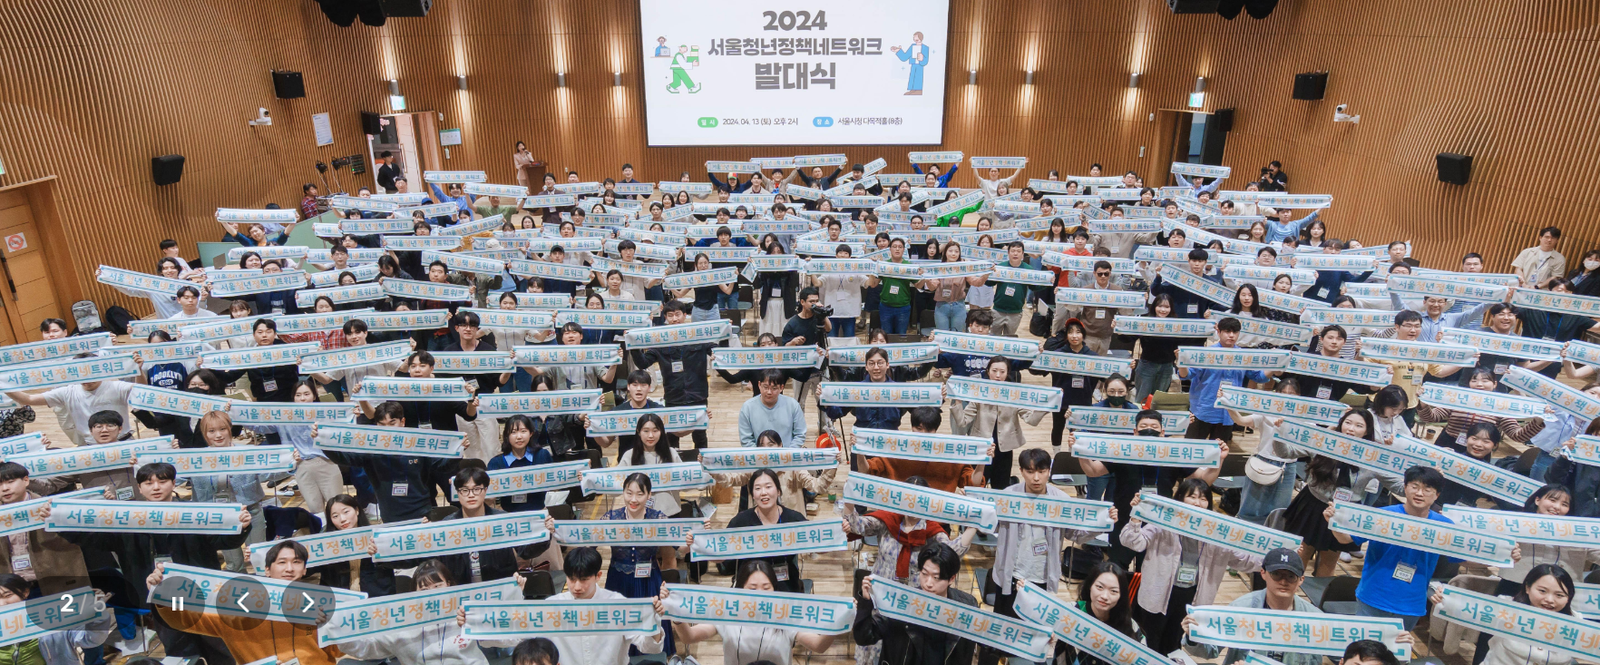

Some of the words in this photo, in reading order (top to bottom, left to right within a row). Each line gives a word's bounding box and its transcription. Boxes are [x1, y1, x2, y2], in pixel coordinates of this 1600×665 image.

[762, 10, 828, 31] 2024
[708, 38, 882, 56] 서울청년정책네트워크
[754, 62, 836, 90] 발대식
[1398, 282, 1494, 298] 서울청년정책네트워크
[566, 315, 642, 324] 서울청년정책네트워크
[1124, 321, 1206, 334] 서울청년정책네트워크
[635, 326, 721, 344] 서울청년정책네트워크
[942, 338, 1028, 355] 서울청년정책네트워크
[1372, 344, 1466, 361] 서울청년정책네트워크
[1453, 334, 1551, 356] 서울청년정책네트워크
[311, 346, 402, 368] 서울청년정책네트워크
[524, 350, 611, 362] 서울청년정책네트워크
[722, 352, 808, 363] 서울청년정책네트워크
[1190, 352, 1278, 366] 서울청년정책네트워크
[8, 362, 124, 384] 서울청년정책네트워크
[832, 388, 930, 402] 서울청년정책네트워크
[954, 383, 1049, 404] 서울청년정책네트워크
[490, 396, 591, 410] 서울청년정책네트워크
[238, 408, 347, 420] 서울청년정책네트워크
[330, 431, 450, 450] 서울청년정책네트워크
[864, 436, 978, 456] 서울청년정책네트워크
[714, 450, 826, 468] 서울청년정책네트워크
[1088, 440, 1205, 460] 서울청년정책네트워크
[852, 482, 982, 518] 서울청년정책네트워크
[66, 508, 224, 526] 서울청년정책네트워크
[390, 522, 532, 551] 서울청년정책네트워크
[705, 528, 834, 553] 서울청년정책네트워크
[1348, 512, 1496, 554] 서울청년정책네트워크
[1280, 554, 1289, 563] M
[679, 596, 835, 624] 서울청년정책네트워크
[882, 590, 1034, 648] 서울청년정책네트워크
[482, 610, 644, 629] 서울청년정책네트워크
